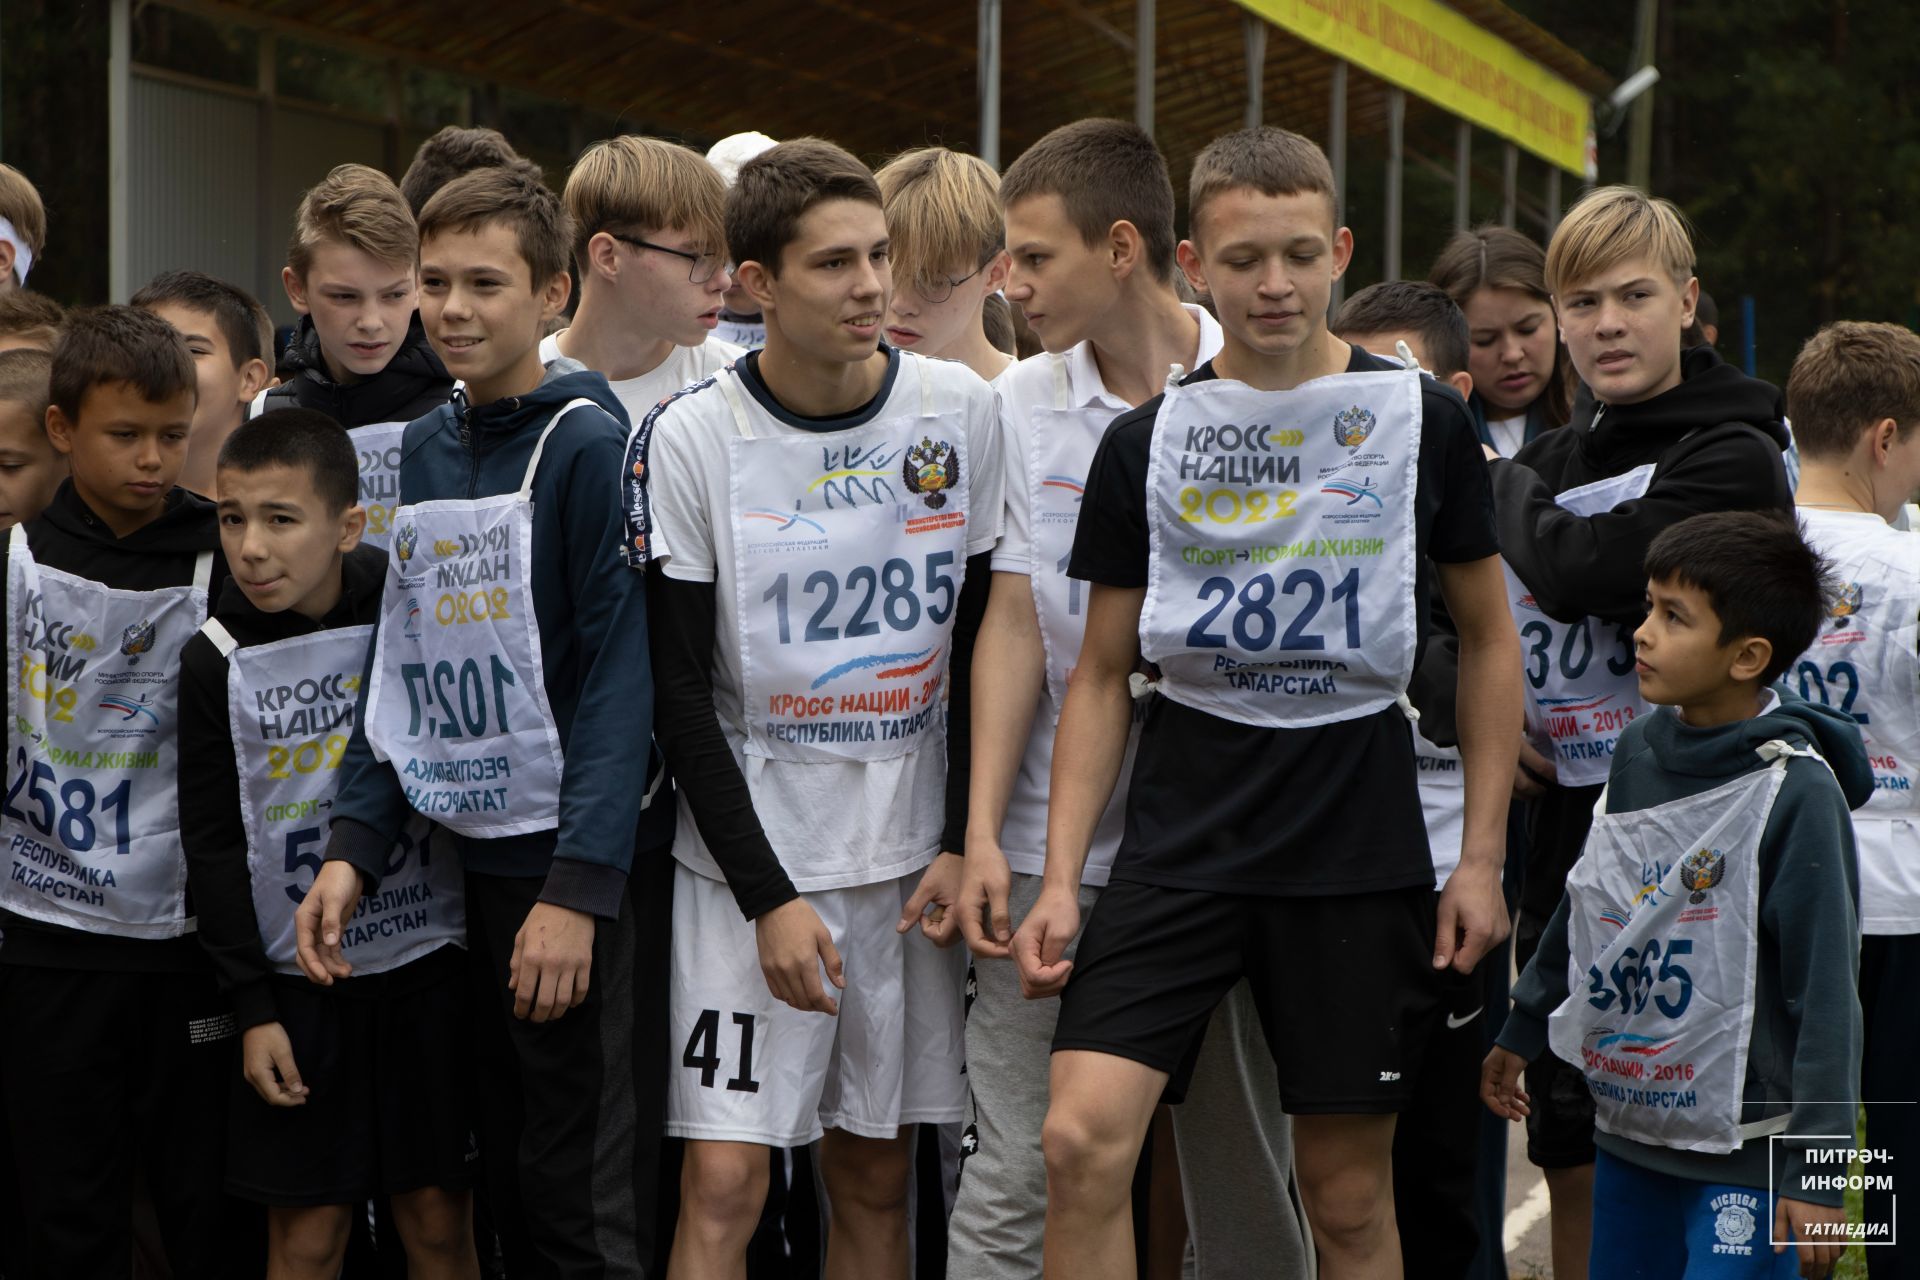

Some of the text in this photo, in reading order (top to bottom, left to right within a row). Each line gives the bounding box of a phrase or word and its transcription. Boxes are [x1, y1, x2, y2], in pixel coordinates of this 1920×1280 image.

[1185, 424, 1270, 452] КРОСС
[1179, 454, 1299, 486] НАЦИИ
[630, 479, 646, 531] ellesse
[1178, 486, 1299, 525] 2022
[1181, 537, 1384, 566] СПОРТ НОРМА ЖИЗНИ
[763, 550, 956, 644] 12285
[1185, 566, 1361, 652] 2821
[255, 673, 343, 712] КРОСС
[1224, 671, 1337, 695] ТАТАРСТАН
[769, 694, 834, 718] КРОСС
[840, 687, 910, 716] НАЦИИ
[259, 701, 356, 741] НАЦИ
[766, 721, 875, 743] РЕСПУБЛИКА
[1594, 706, 1634, 733] 2013
[95, 751, 159, 769] ЖИЗНИ
[1, 745, 131, 856] 2581
[265, 799, 319, 822] СПОРТ
[11, 834, 117, 889] РЕСПУБЛИКА
[11, 861, 105, 907] ТАТАРСТАН
[683, 1009, 759, 1093] 41
[1654, 1064, 1694, 1081] 2016
[1627, 1087, 1697, 1109] ТАТАРСТАН
[1713, 1244, 1752, 1255] STATE
